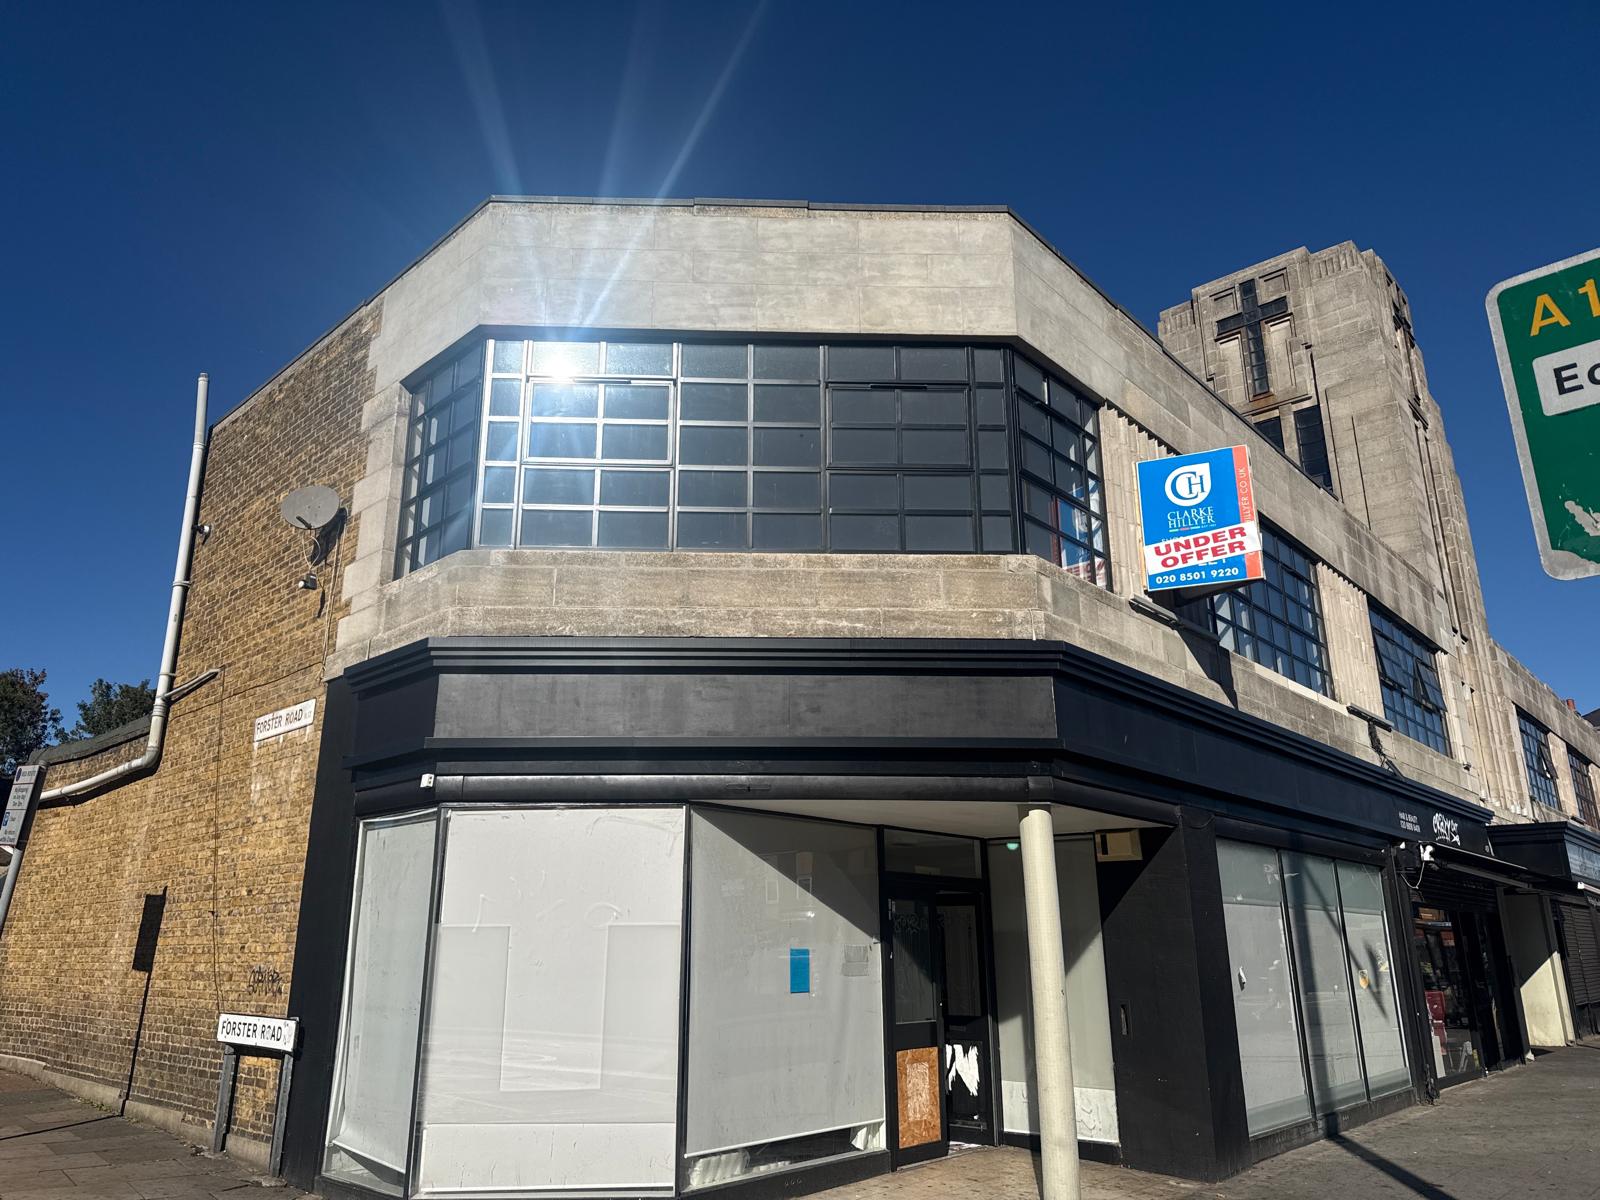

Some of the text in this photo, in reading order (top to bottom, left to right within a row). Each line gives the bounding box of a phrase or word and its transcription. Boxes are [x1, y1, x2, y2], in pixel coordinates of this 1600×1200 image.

[1167, 506, 1214, 521] CLARKE
[1168, 515, 1215, 528] HILLYER
[1154, 526, 1246, 556] UNDER
[1161, 540, 1246, 568] OFFER
[1156, 567, 1239, 584] 020 8501 9220
[256, 715, 282, 734] FORSTER
[285, 709, 303, 725] ROAD
[221, 1020, 283, 1042] FORSTER ROAD
